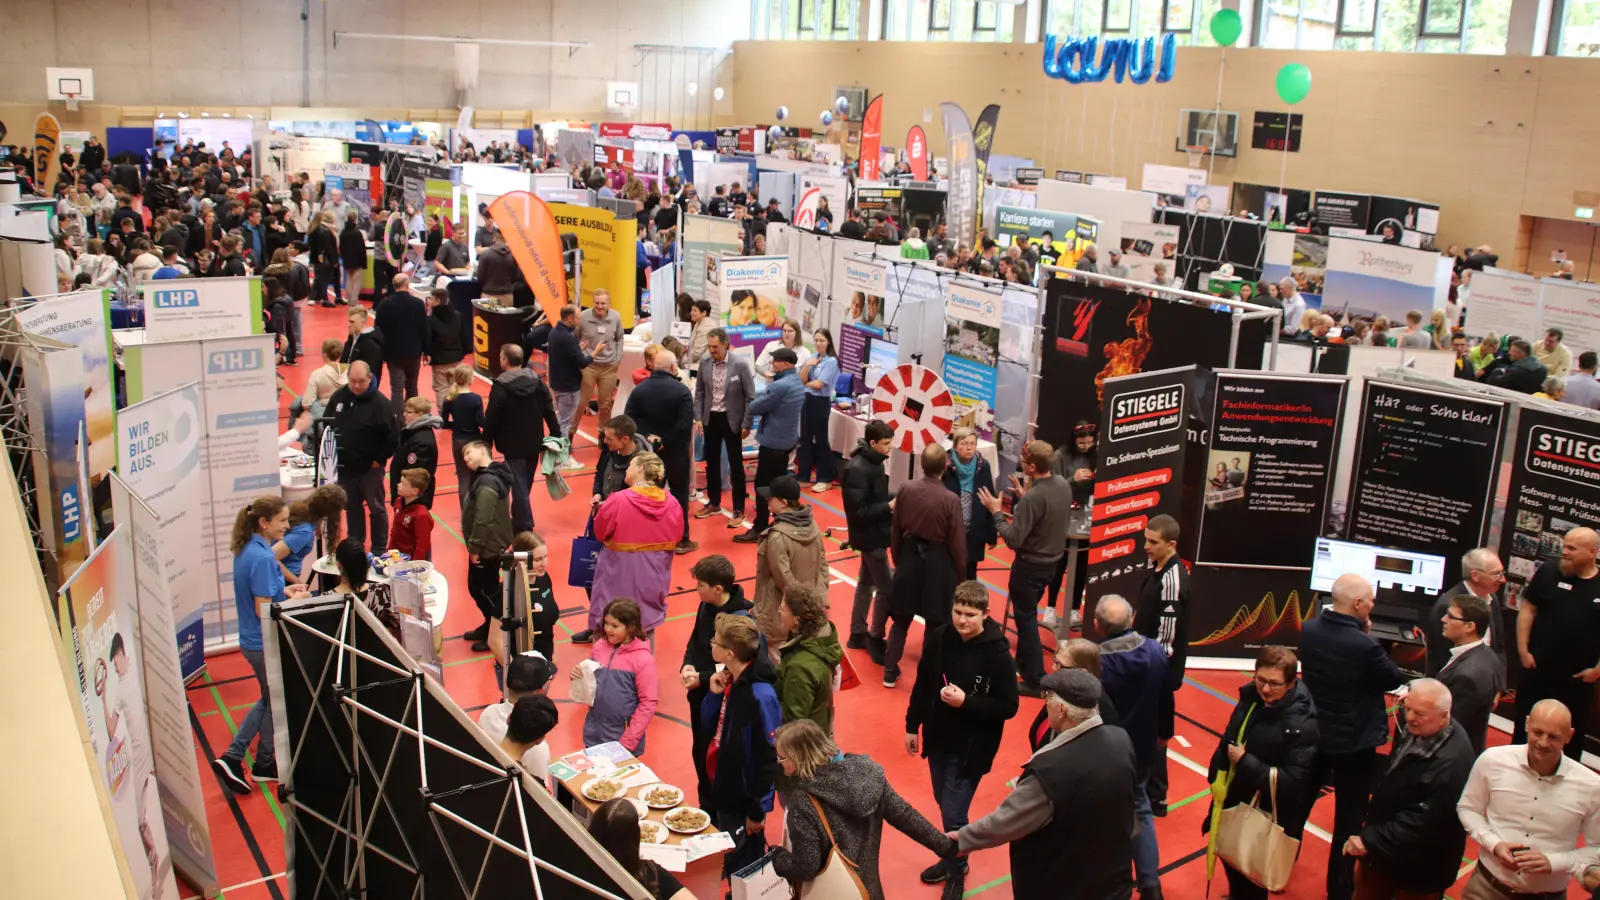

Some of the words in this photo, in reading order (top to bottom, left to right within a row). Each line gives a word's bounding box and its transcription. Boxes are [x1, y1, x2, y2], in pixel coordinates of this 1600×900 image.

[1000, 211, 1028, 225] Karriere
[1029, 216, 1055, 229] starten
[726, 268, 765, 277] Diakonie
[158, 290, 195, 307] LHP
[951, 293, 981, 308] Diakonie
[1116, 390, 1179, 418] STIEGELE
[1222, 399, 1312, 413] Fachinformatiker/in
[1374, 394, 1401, 409] Hä?
[1405, 403, 1424, 413] oder
[1429, 404, 1459, 419] Scho
[1461, 409, 1493, 425] klar!
[1113, 419, 1158, 435] Datensysteme
[1159, 414, 1178, 426] GmbH
[1221, 410, 1334, 427] Anwendungsentwicklung
[128, 420, 150, 441] WIR
[129, 430, 169, 458] BILDEN
[1219, 433, 1257, 443] Technische
[1259, 435, 1318, 448] Programmierung
[1537, 433, 1600, 463] STIEG
[1106, 456, 1118, 466] Die
[1118, 444, 1180, 464] Software-Spezialisten
[129, 454, 156, 476] AUS.
[1519, 495, 1543, 507] Mess-
[1548, 504, 1565, 513] und
[1520, 484, 1557, 500] Software
[1557, 495, 1574, 505] und
[62, 492, 80, 538] LHP
[1104, 520, 1143, 536] Auswertung
[1101, 544, 1130, 558] Regelung
